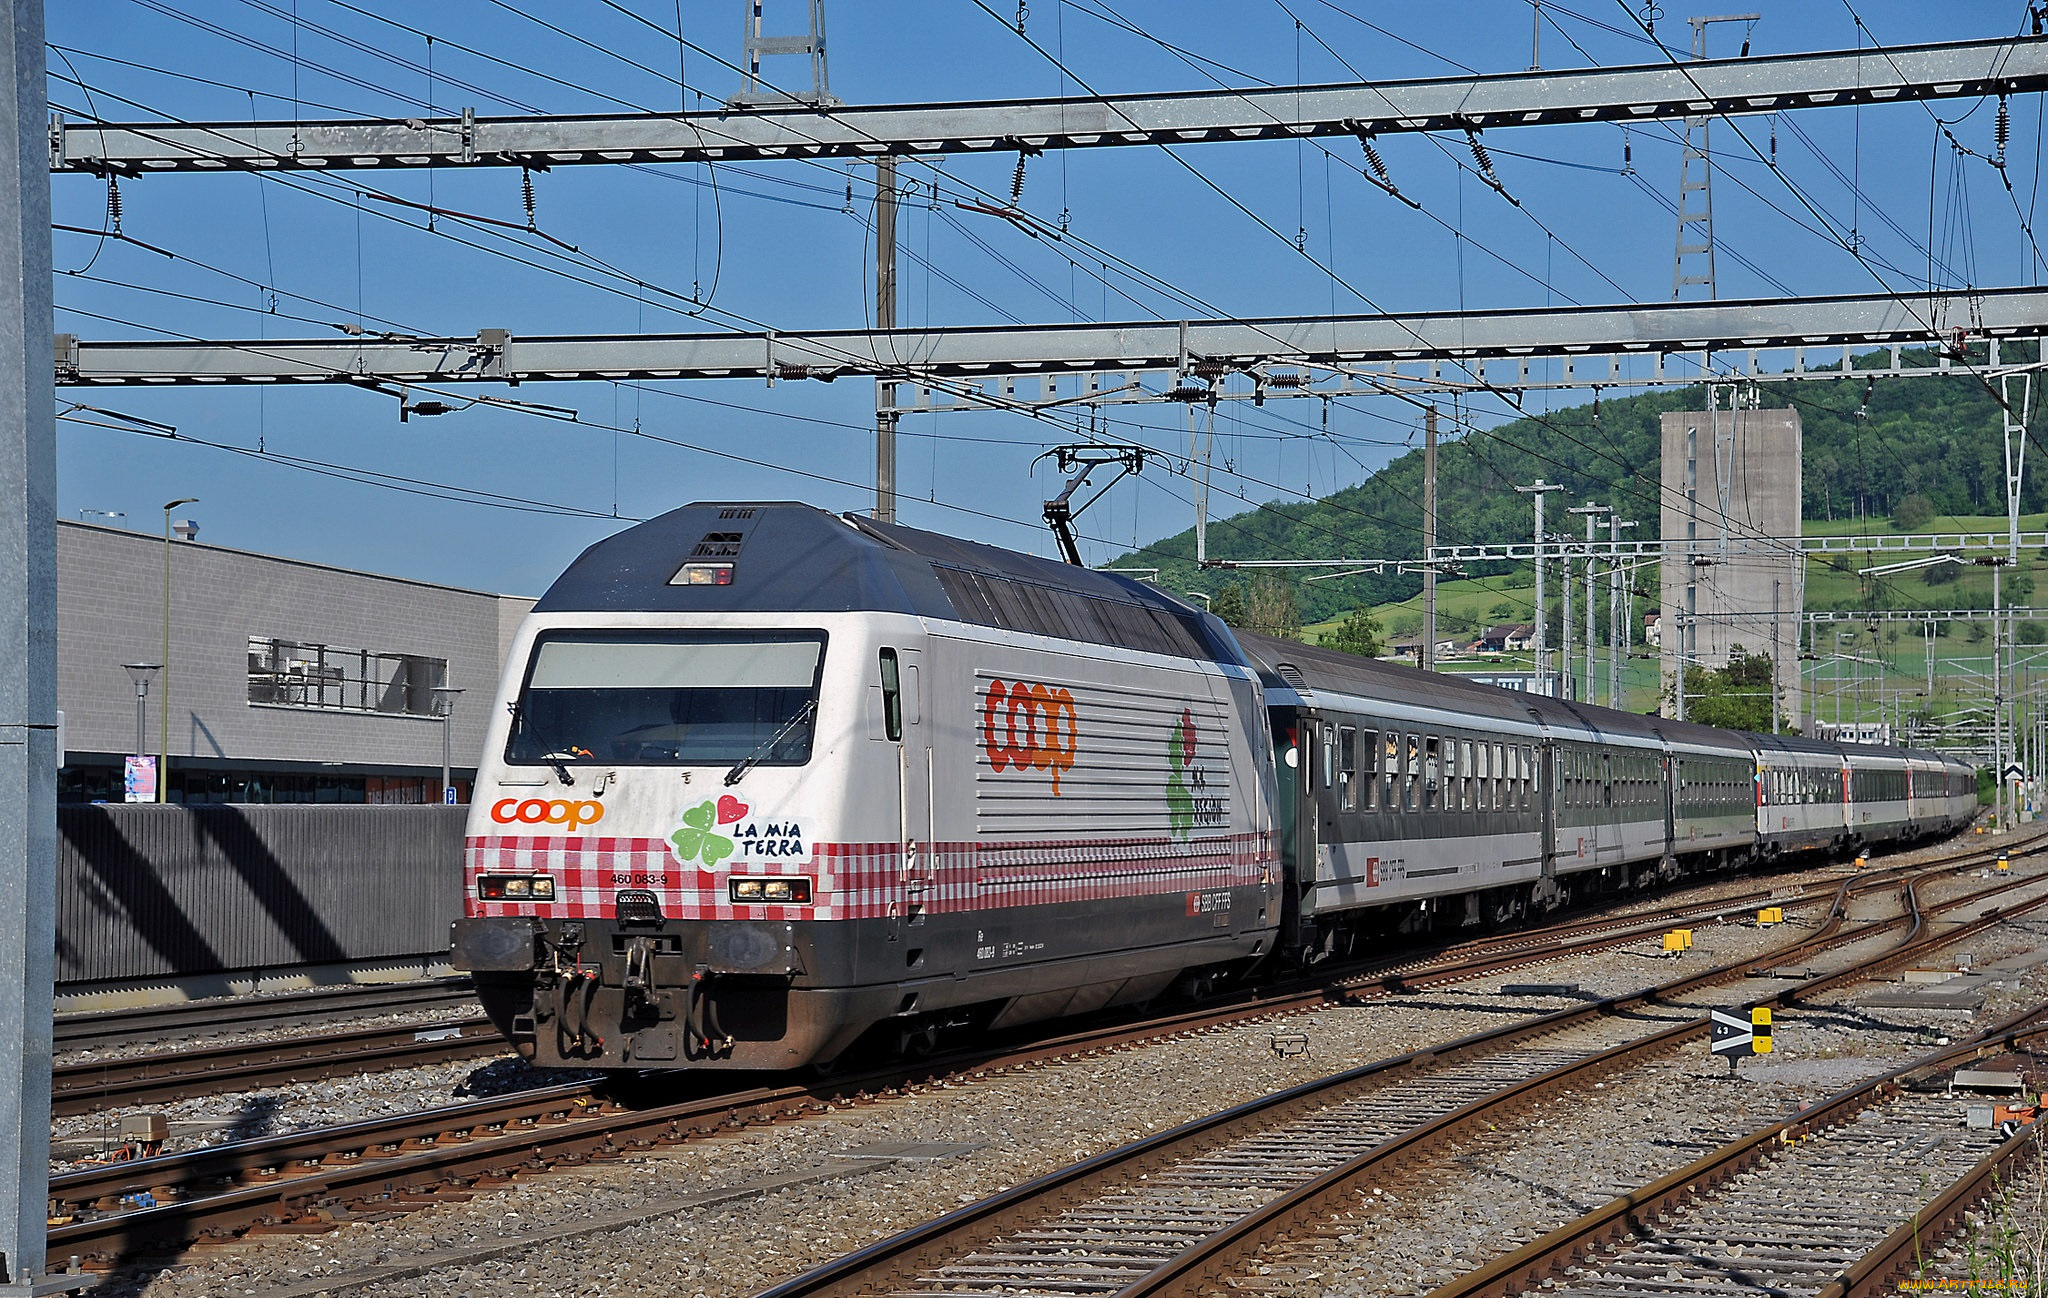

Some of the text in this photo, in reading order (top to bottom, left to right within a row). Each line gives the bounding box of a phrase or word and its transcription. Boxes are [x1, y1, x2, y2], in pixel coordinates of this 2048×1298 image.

[984, 680, 1078, 797] coop
[491, 798, 605, 832] coop
[733, 821, 801, 838] LA MIA
[742, 840, 804, 857] TERRA
[610, 874, 668, 885] 460 083-9
[1201, 891, 1231, 913] SBB CFF FFS
[1716, 1026, 1729, 1035] 43
